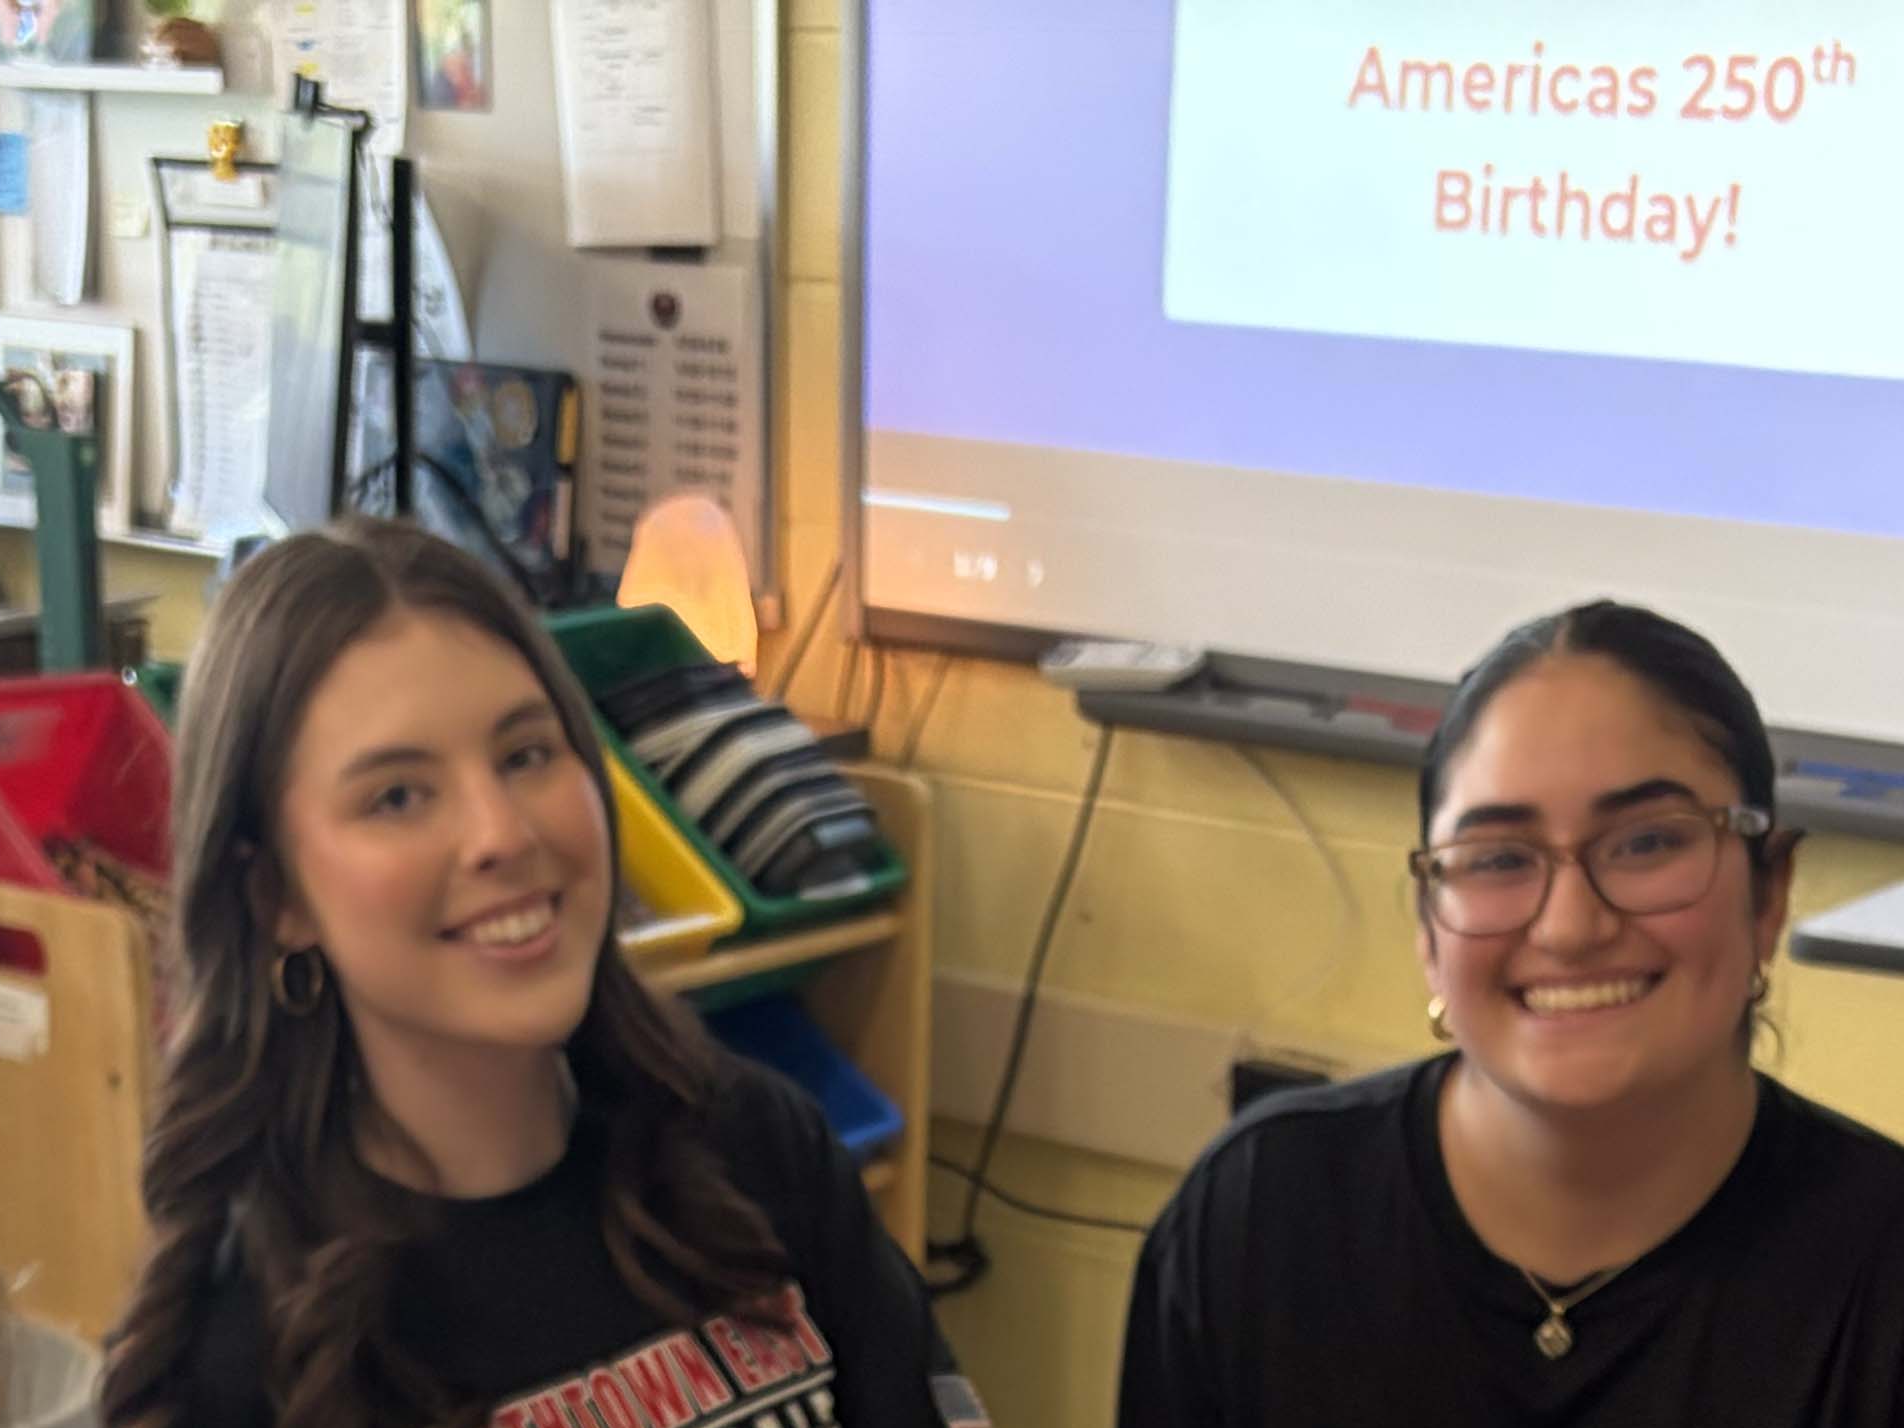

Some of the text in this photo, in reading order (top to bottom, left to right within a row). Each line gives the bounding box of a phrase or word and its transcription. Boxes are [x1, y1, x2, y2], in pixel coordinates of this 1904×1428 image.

[1346, 39, 1857, 123] Americas 250th
[1432, 162, 1741, 263] Birthday!
